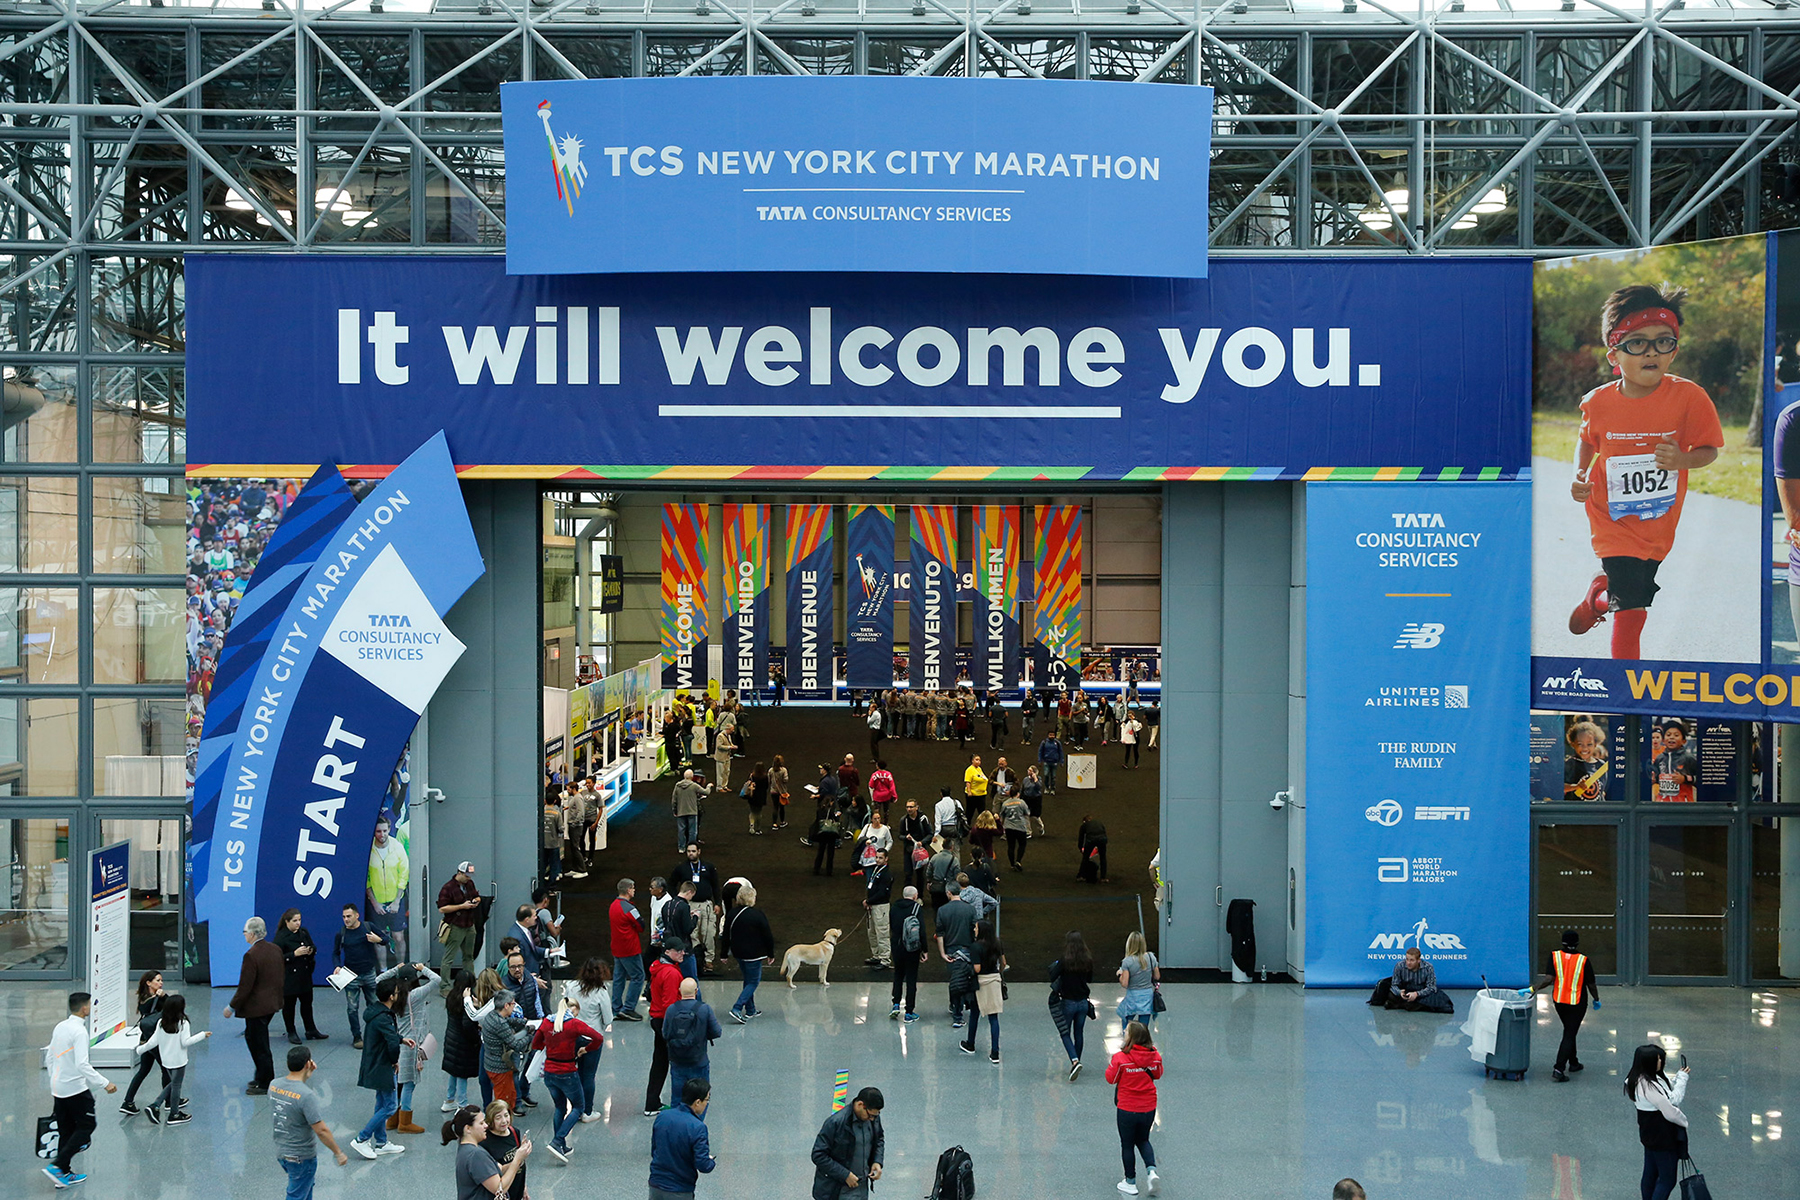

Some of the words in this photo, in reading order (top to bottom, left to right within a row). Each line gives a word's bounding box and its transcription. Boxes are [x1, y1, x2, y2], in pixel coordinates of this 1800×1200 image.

[604, 146, 684, 177] TCS
[697, 151, 775, 175] NEW
[783, 150, 877, 174] YORK
[885, 150, 964, 174] CITY
[974, 152, 1160, 181] MARATHON
[756, 206, 807, 221] TATA
[812, 206, 932, 221] CONSULTANCY
[936, 207, 1012, 222] SERVICES
[338, 308, 410, 386] It
[441, 306, 620, 386] will
[654, 306, 1126, 388] welcome
[1157, 326, 1382, 404] you.
[1621, 468, 1669, 495] 1052
[1392, 513, 1446, 528] TATA
[301, 489, 411, 620] MARATHON
[1355, 533, 1482, 548] CONSULTANCY
[1379, 552, 1459, 568] SERVICES
[339, 630, 442, 645] CONSULTANCY
[368, 615, 412, 628] TATA
[677, 583, 693, 689] WELCOME
[738, 561, 754, 690] BIENVENIDO
[801, 570, 817, 690] BIENVENUE
[924, 561, 941, 691] BENVENUTO
[988, 548, 1004, 691] WILLKOMMEN
[271, 621, 309, 682] CITY
[358, 648, 424, 661] SERVICES
[1047, 625, 1067, 691] ようこそ
[1364, 698, 1440, 706] AIRLINES
[1380, 687, 1440, 696] UNITED
[1625, 669, 1800, 707] WELCO
[244, 686, 283, 758] YORK
[1378, 742, 1407, 754] THE
[1411, 742, 1457, 754] RUDIN
[1394, 757, 1444, 769] FAMILY
[230, 765, 259, 830] NEW
[293, 714, 367, 900] START
[1414, 806, 1471, 821] ESPN
[222, 840, 246, 892] TCS
